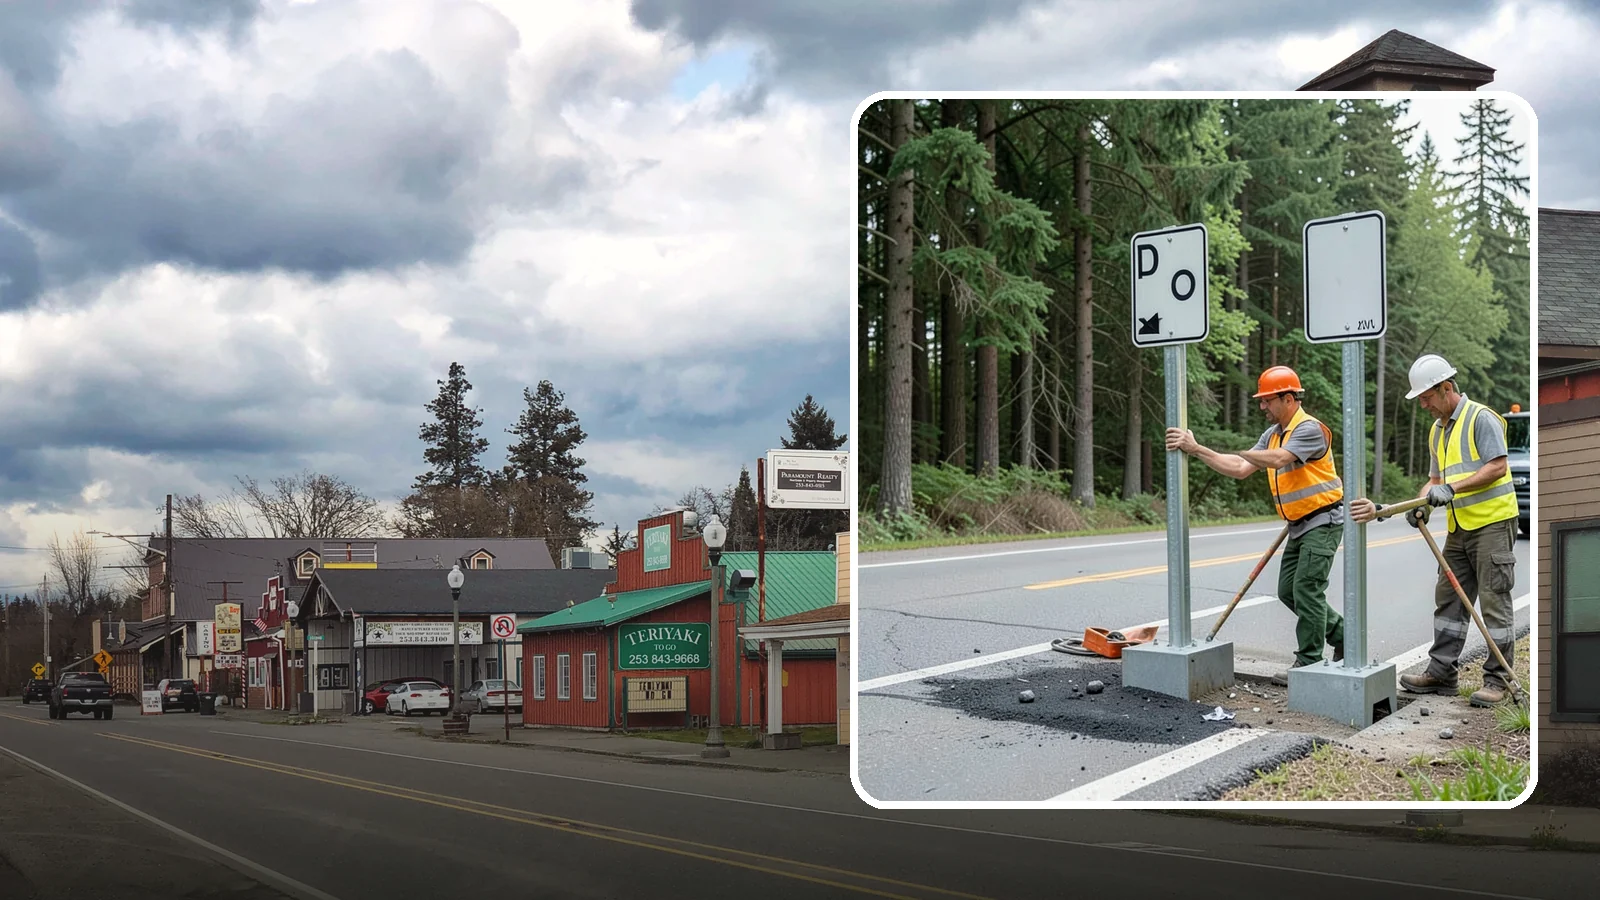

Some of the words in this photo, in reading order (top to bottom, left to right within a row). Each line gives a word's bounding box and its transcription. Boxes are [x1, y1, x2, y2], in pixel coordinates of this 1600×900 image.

[781, 471, 815, 479] PARAMOUNT
[817, 472, 839, 480] REALTY
[646, 531, 669, 549] TERIYAKI
[625, 627, 702, 646] TERIYAKI
[628, 654, 648, 664] 253
[651, 653, 700, 664] 843-9668
